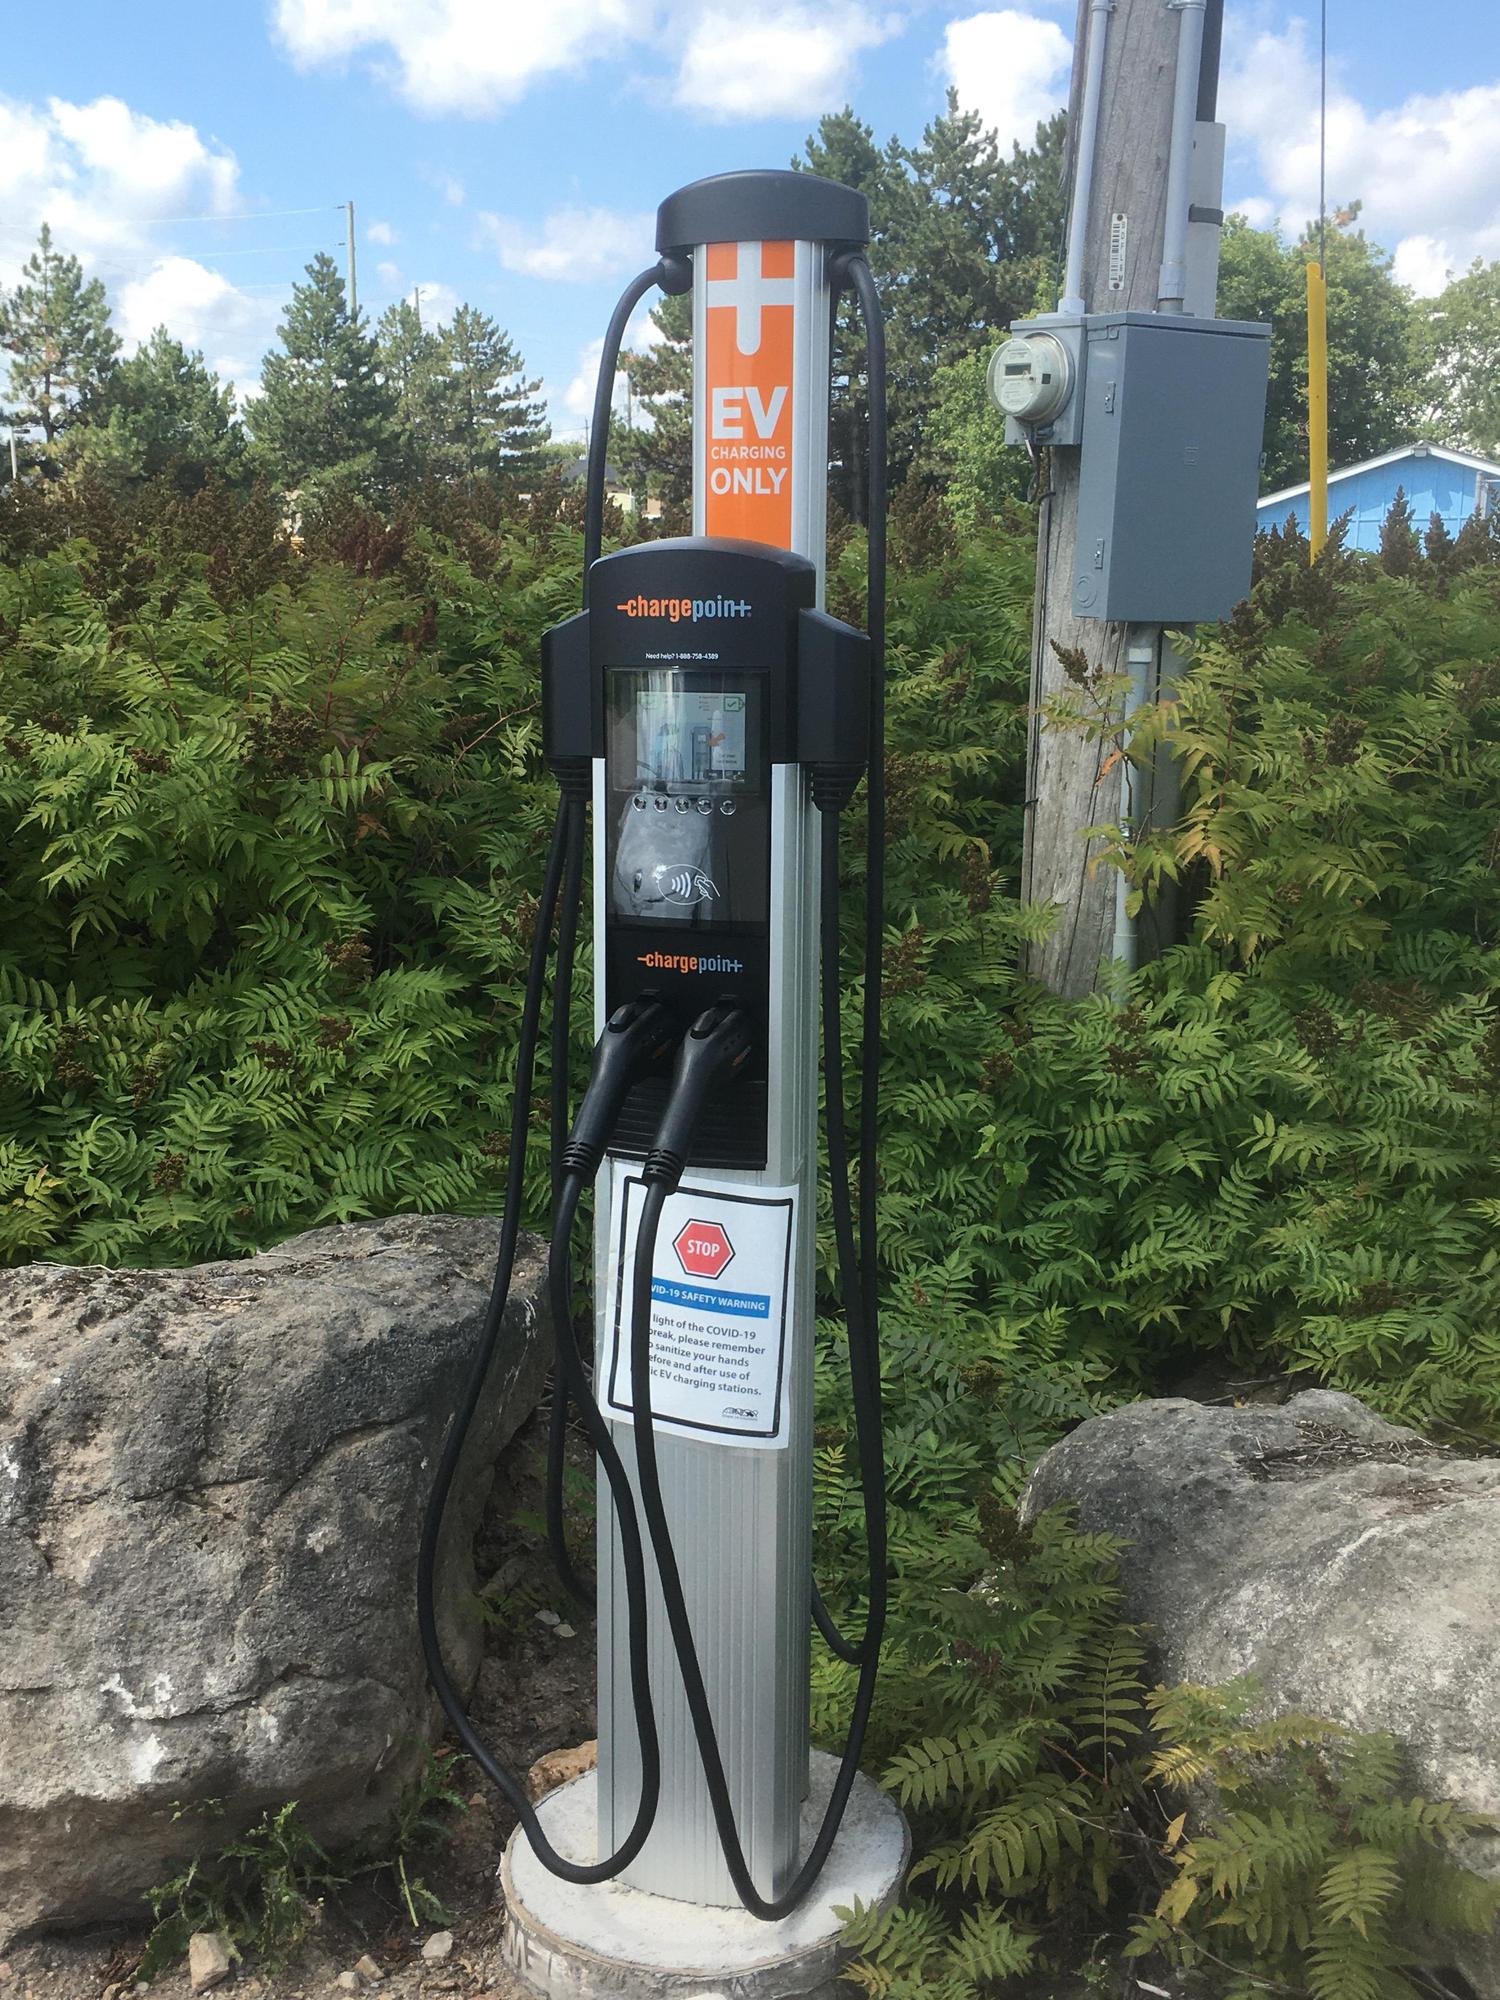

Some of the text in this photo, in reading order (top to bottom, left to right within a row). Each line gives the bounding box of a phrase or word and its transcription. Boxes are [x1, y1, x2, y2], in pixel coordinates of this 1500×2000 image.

[711, 386, 789, 439] EV
[711, 446, 786, 460] CHARGING
[710, 467, 788, 495] ONLY
[687, 1239, 720, 1257] STOP
[651, 1284, 766, 1311] VID-19 SAFETY WARNING
[652, 1313, 756, 1340] light of the COVID-19
[655, 1342, 691, 1357] sanitize
[693, 1351, 716, 1361] your
[718, 1353, 750, 1367] hands
[678, 1334, 710, 1348] please
[711, 1342, 766, 1355] remember
[649, 1354, 751, 1381] efore and after use of
[659, 1370, 672, 1380] EV
[673, 1373, 716, 1391] charging
[718, 1383, 762, 1396] stations.
